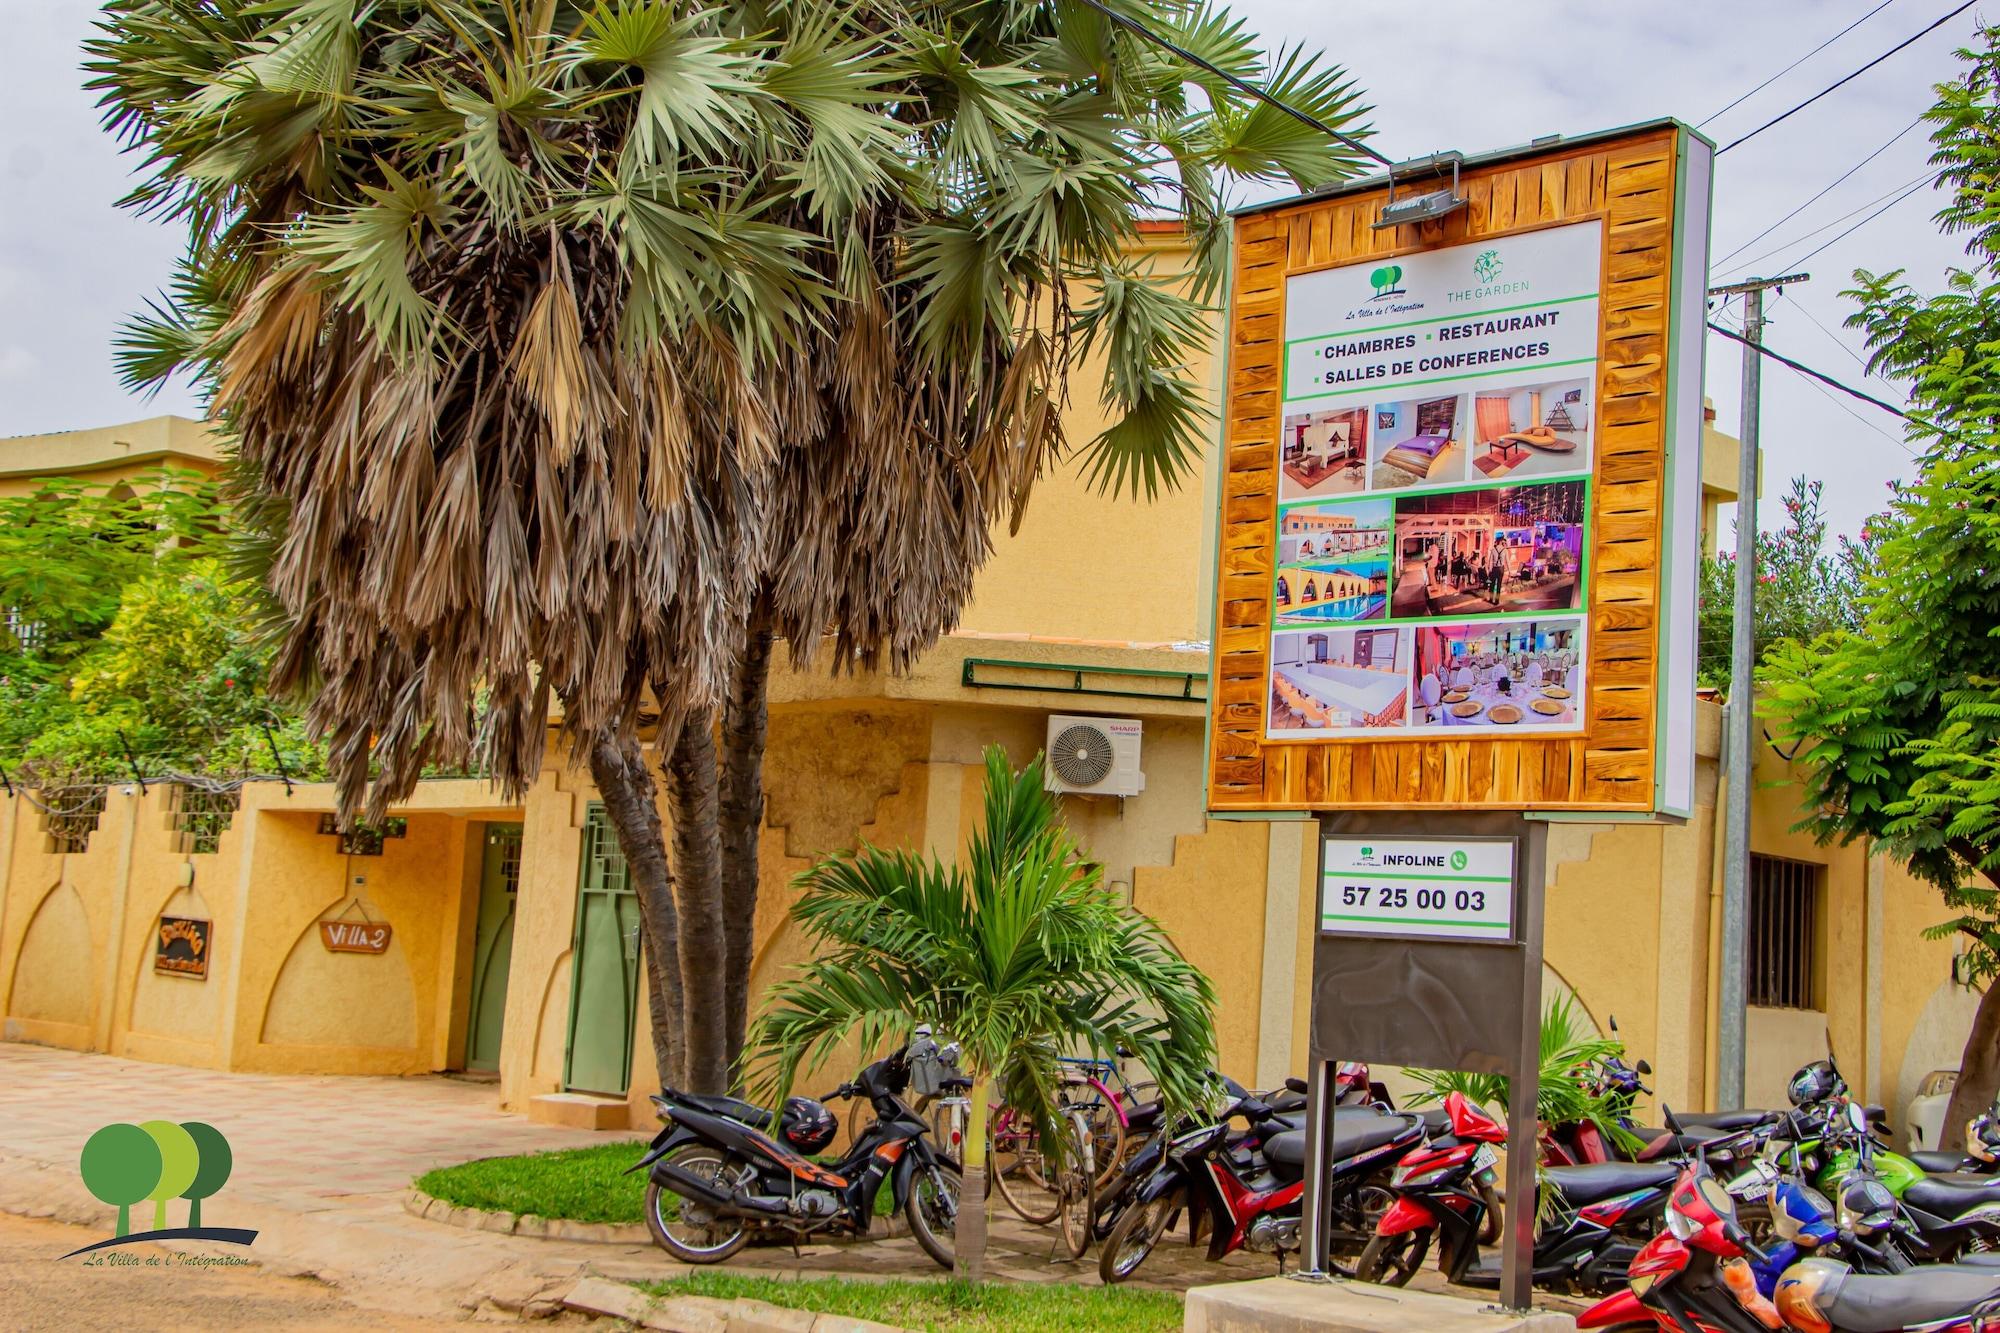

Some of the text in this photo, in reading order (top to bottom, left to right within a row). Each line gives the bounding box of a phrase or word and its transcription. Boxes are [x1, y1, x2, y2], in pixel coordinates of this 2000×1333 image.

[1447, 280, 1530, 303] THE GARDEN
[1345, 311, 1355, 320] La
[1358, 308, 1373, 318] Villa
[1375, 308, 1383, 316] de
[1324, 311, 1560, 360] CHAMBRES RESTAURANT
[1325, 341, 1550, 385] SALLES DE CONFERENCES
[1383, 854, 1445, 867] INFOLINE
[1342, 886, 1485, 912] 57 25 00 03
[370, 928, 386, 948] 2
